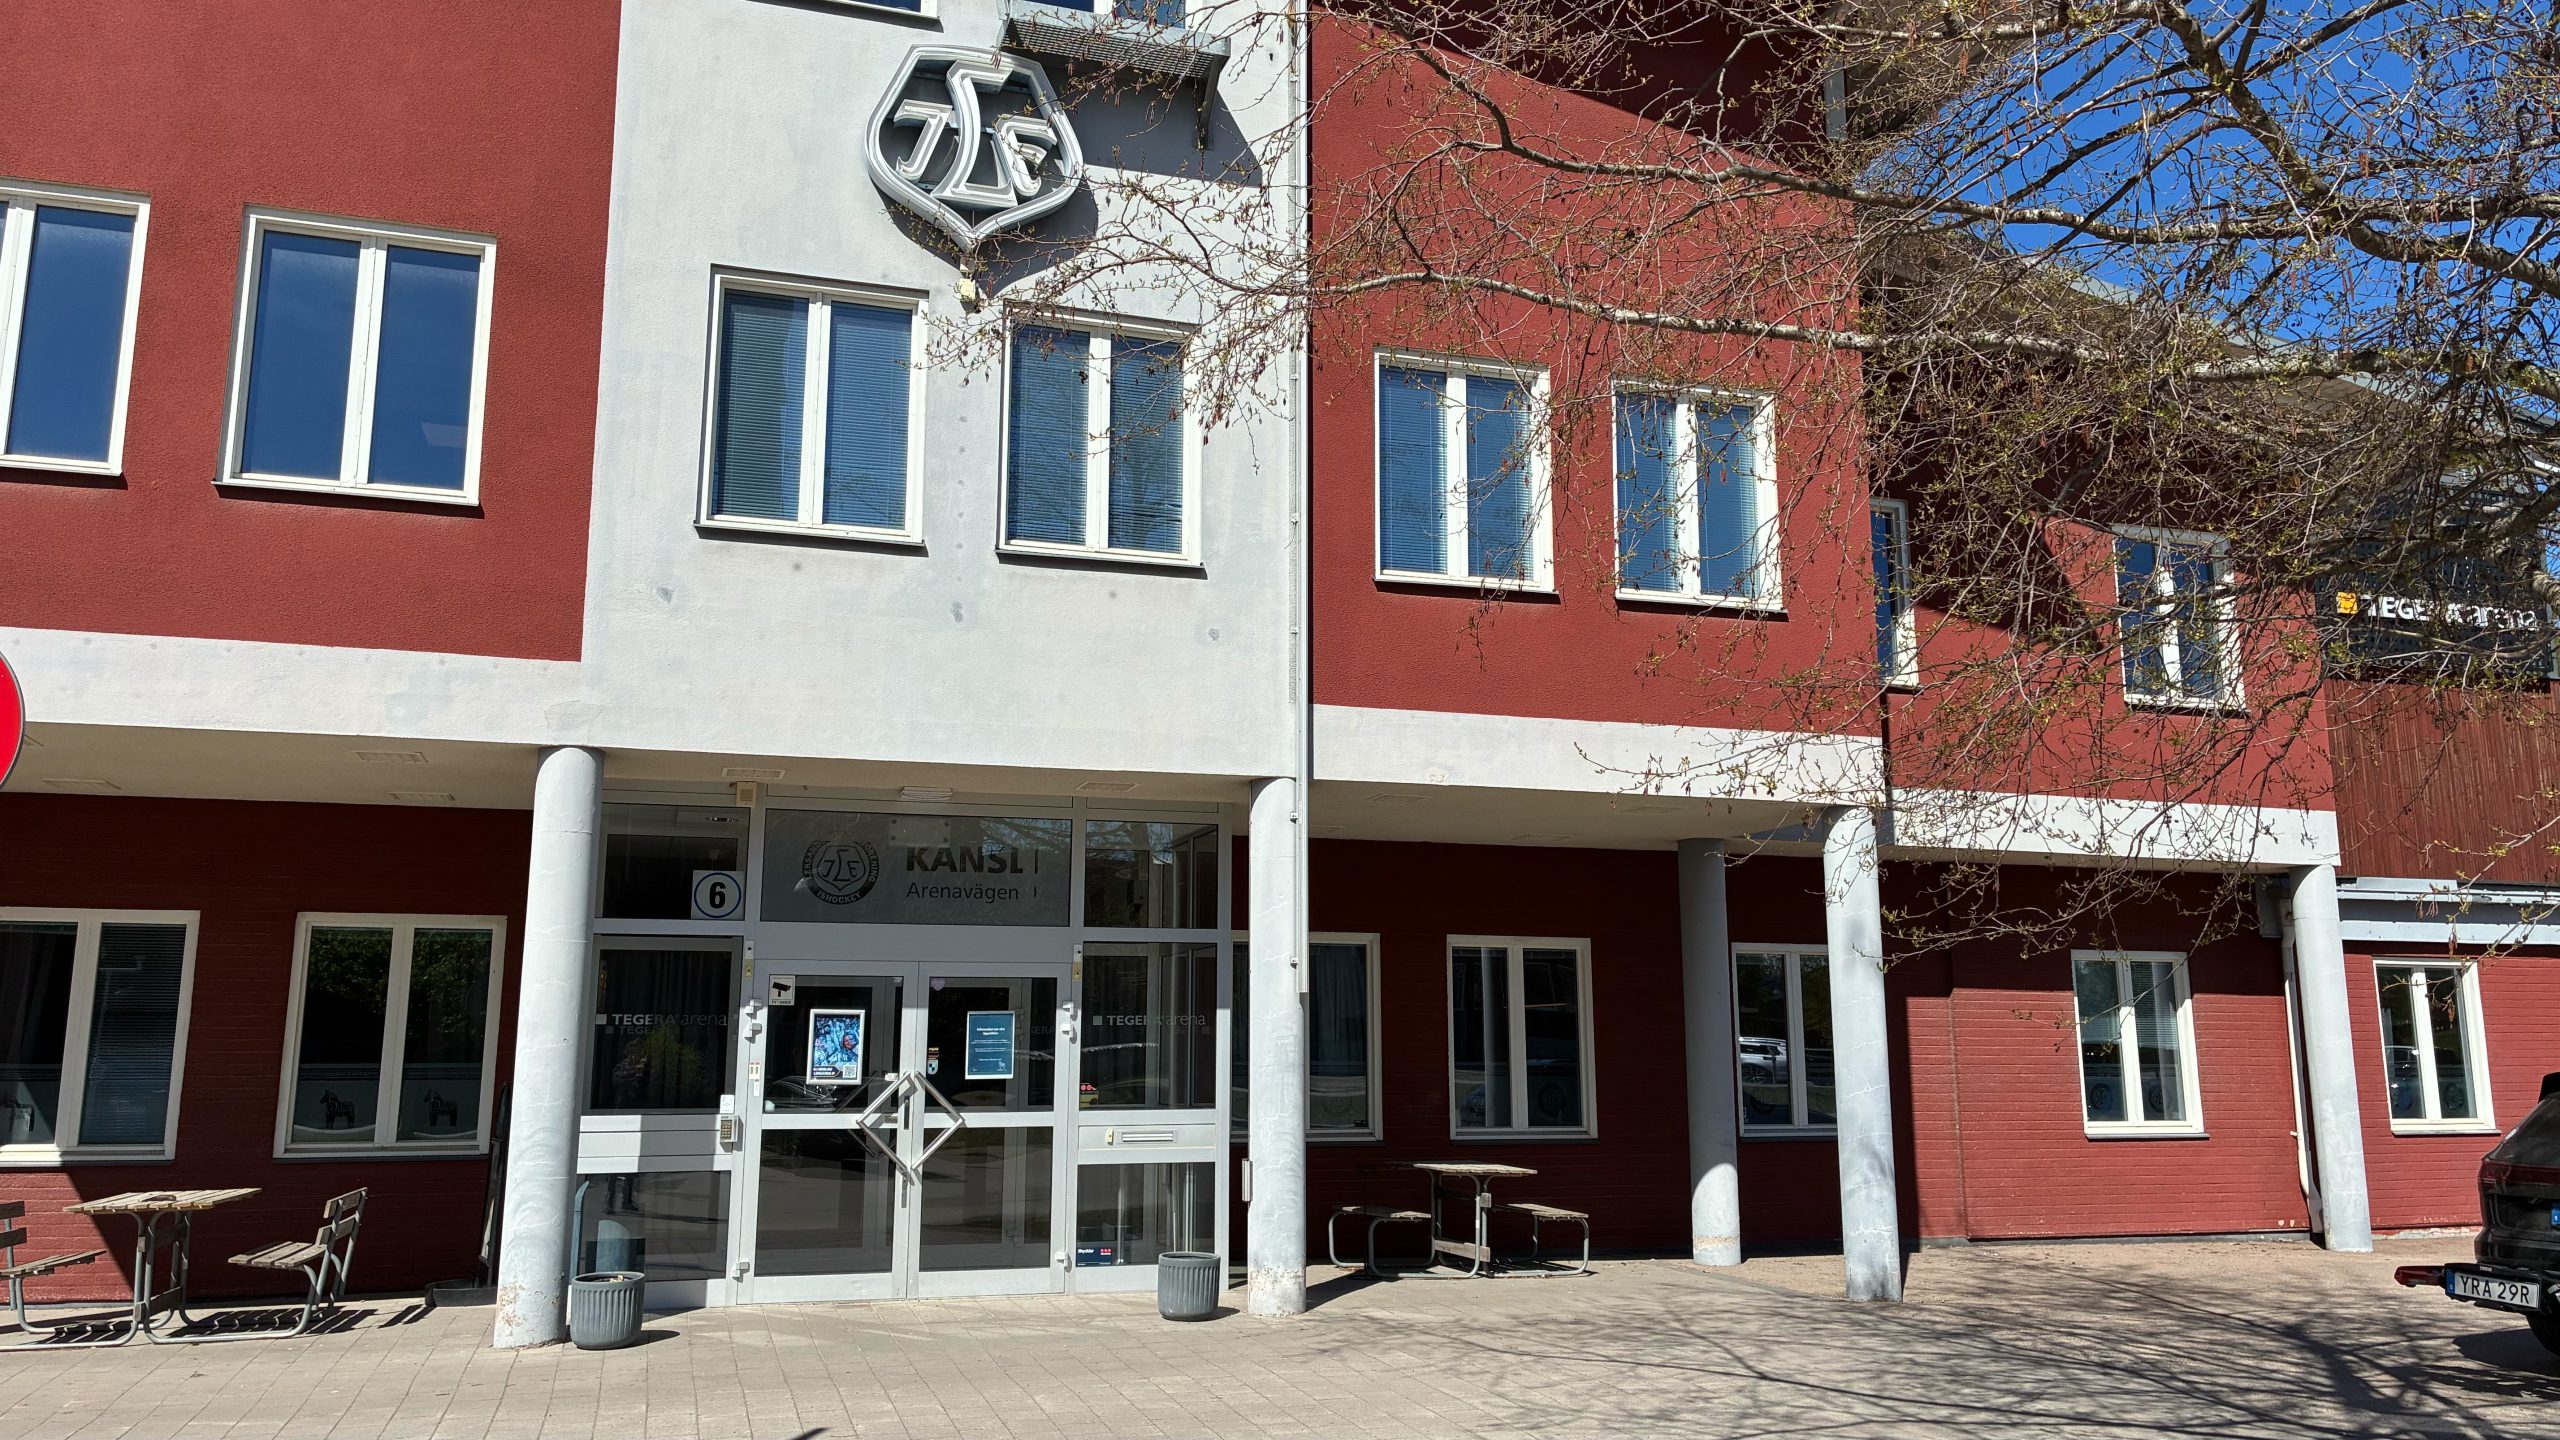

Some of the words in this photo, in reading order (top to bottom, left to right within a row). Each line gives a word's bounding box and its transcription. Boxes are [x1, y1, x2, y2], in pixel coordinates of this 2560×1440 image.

[709, 881, 726, 909] 6
[817, 889, 861, 904] ISHOCKEY
[905, 881, 1019, 904] Arenavägen
[681, 1014, 728, 1026] arena
[1166, 1014, 1206, 1026] arena
[2460, 1275, 2492, 1298] YRA
[2497, 1281, 2530, 1304] 29R
